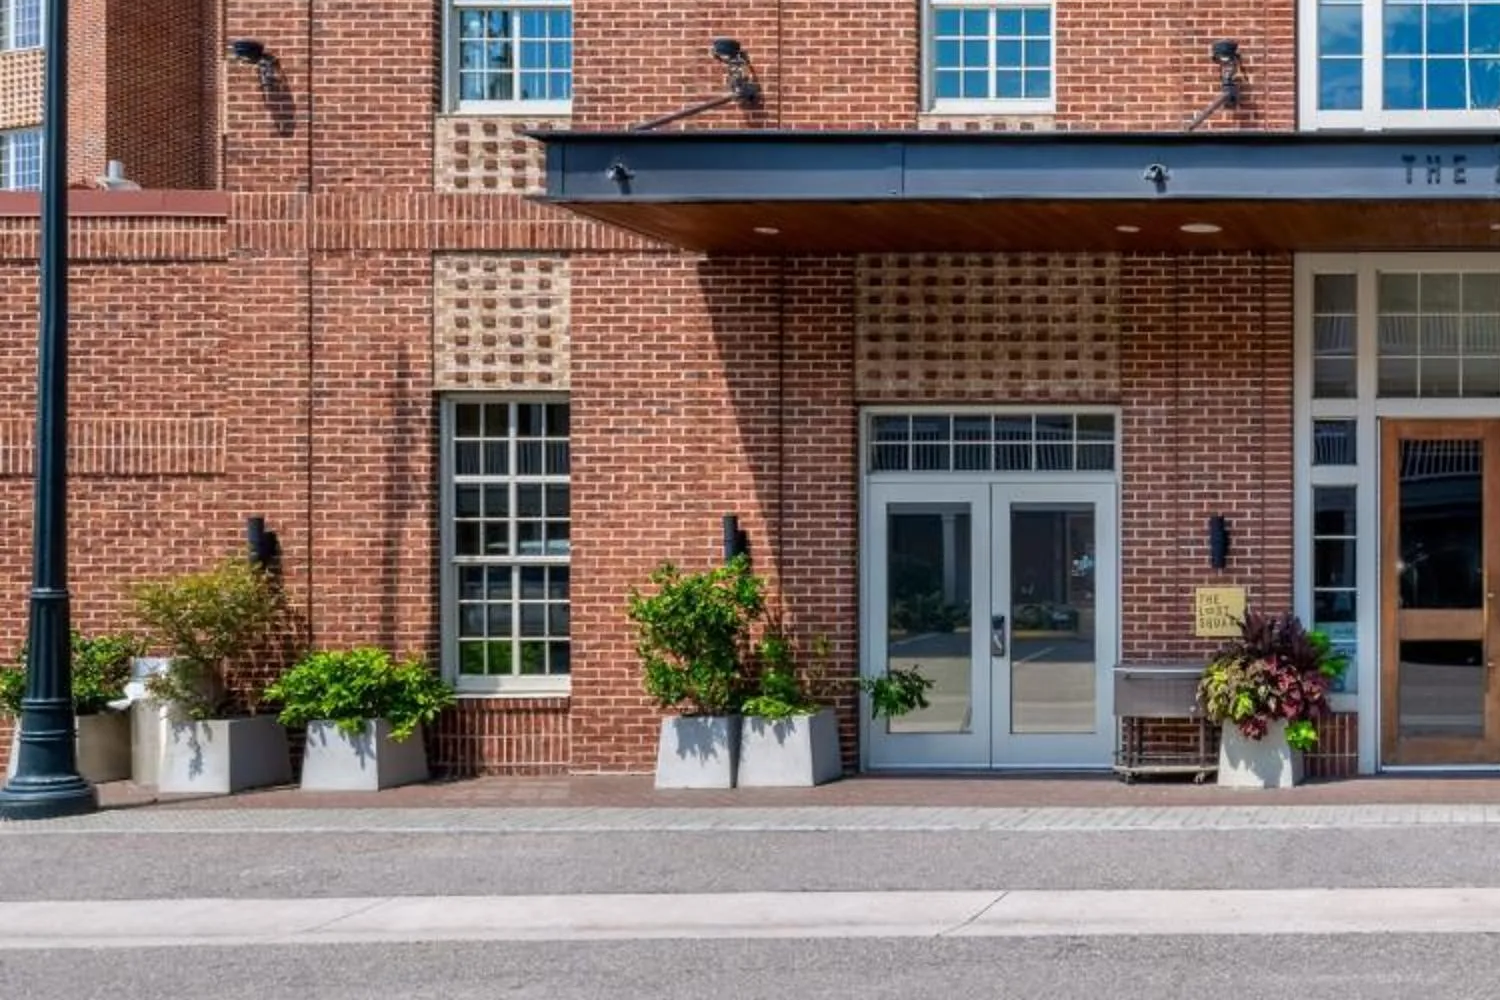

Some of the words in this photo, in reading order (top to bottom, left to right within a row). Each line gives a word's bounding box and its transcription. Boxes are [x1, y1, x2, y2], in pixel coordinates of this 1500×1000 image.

[1402, 154, 1467, 185] THE
[1199, 593, 1222, 605] THE
[1199, 605, 1229, 617] LOST
